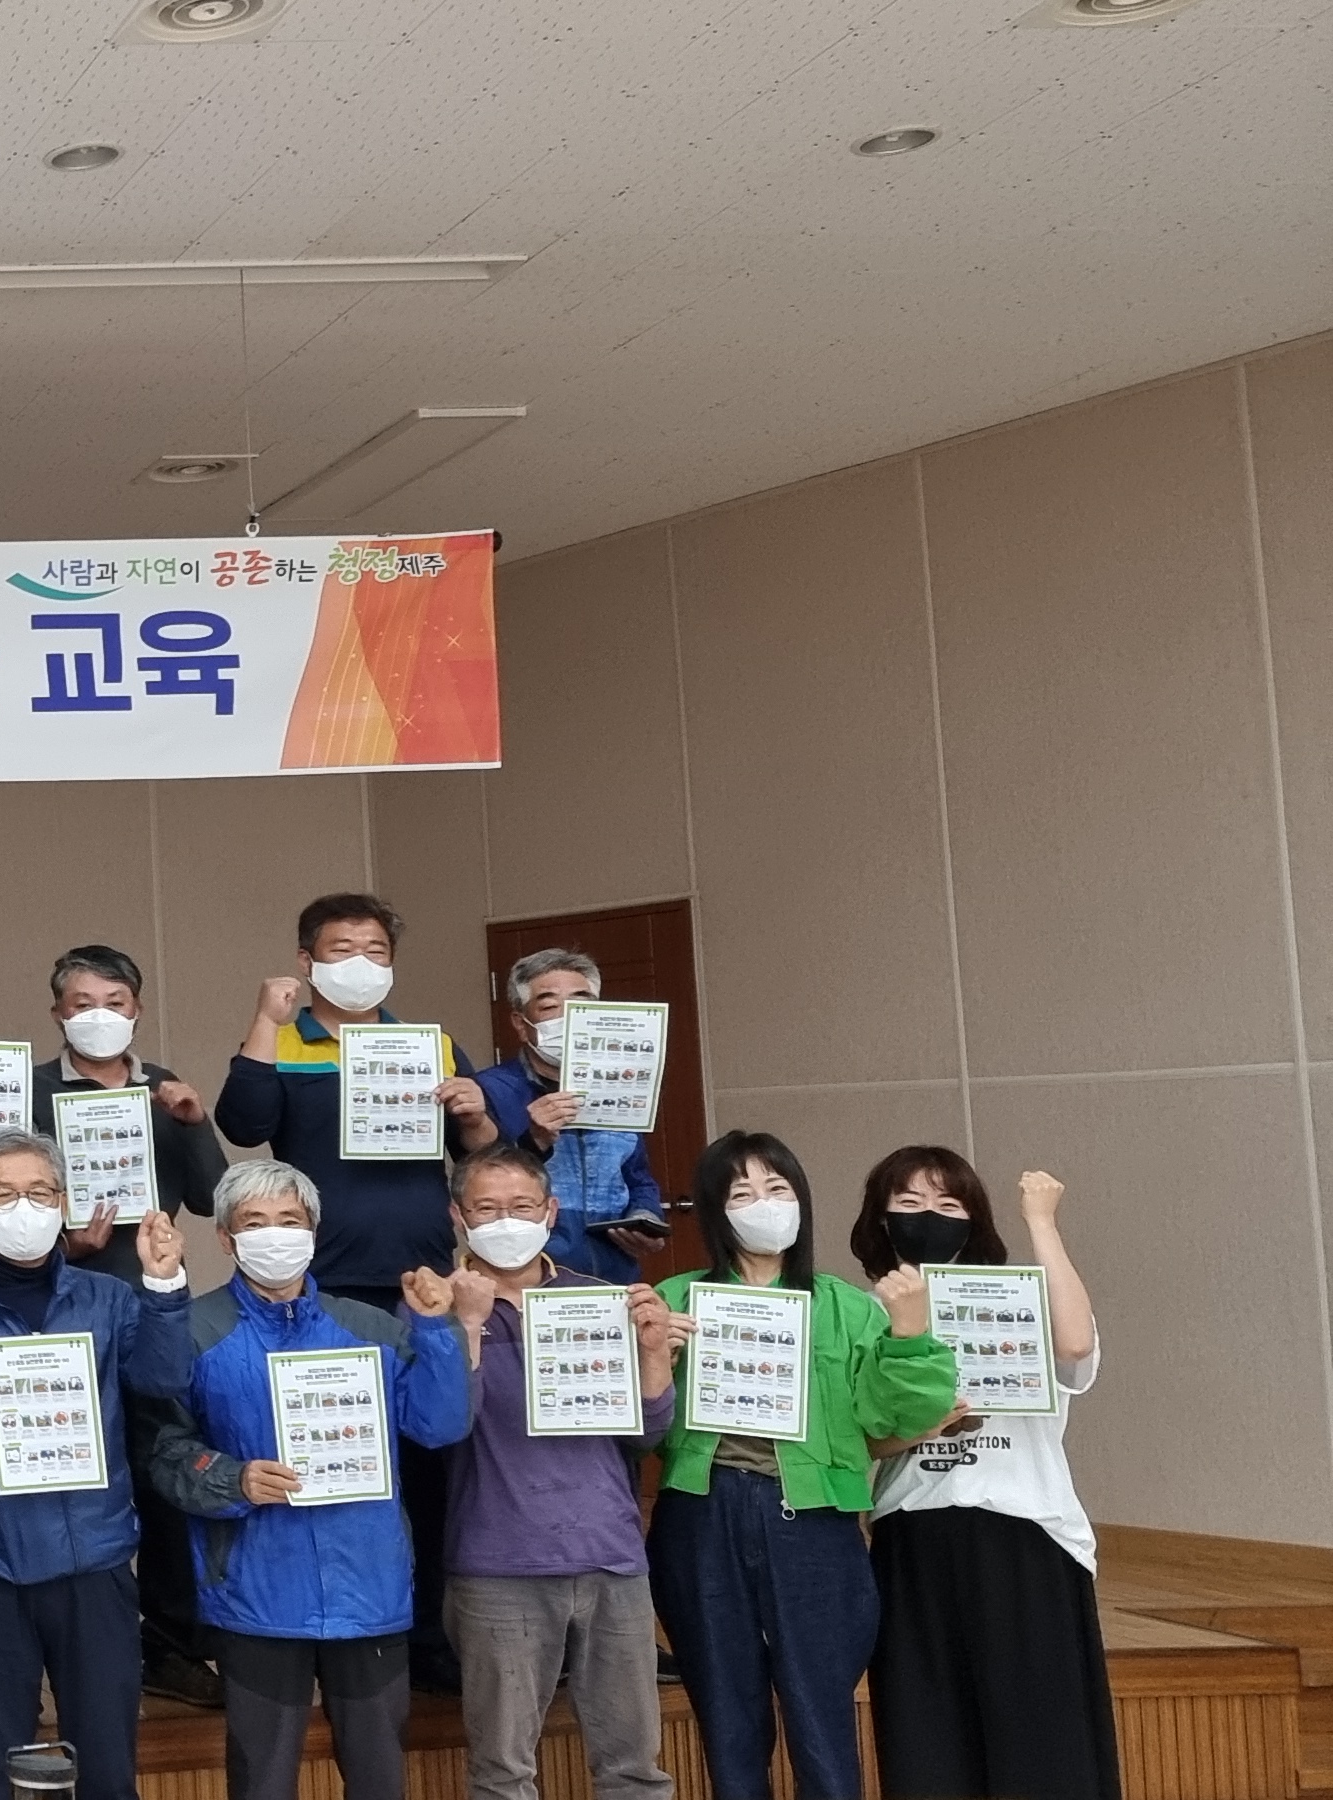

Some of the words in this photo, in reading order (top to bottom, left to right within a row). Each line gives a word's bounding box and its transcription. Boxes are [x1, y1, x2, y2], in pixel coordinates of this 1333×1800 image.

[42, 558, 119, 588] 사람과
[126, 556, 201, 586] 자연이
[210, 550, 318, 588] 공존하는
[30, 610, 241, 716] 교육
